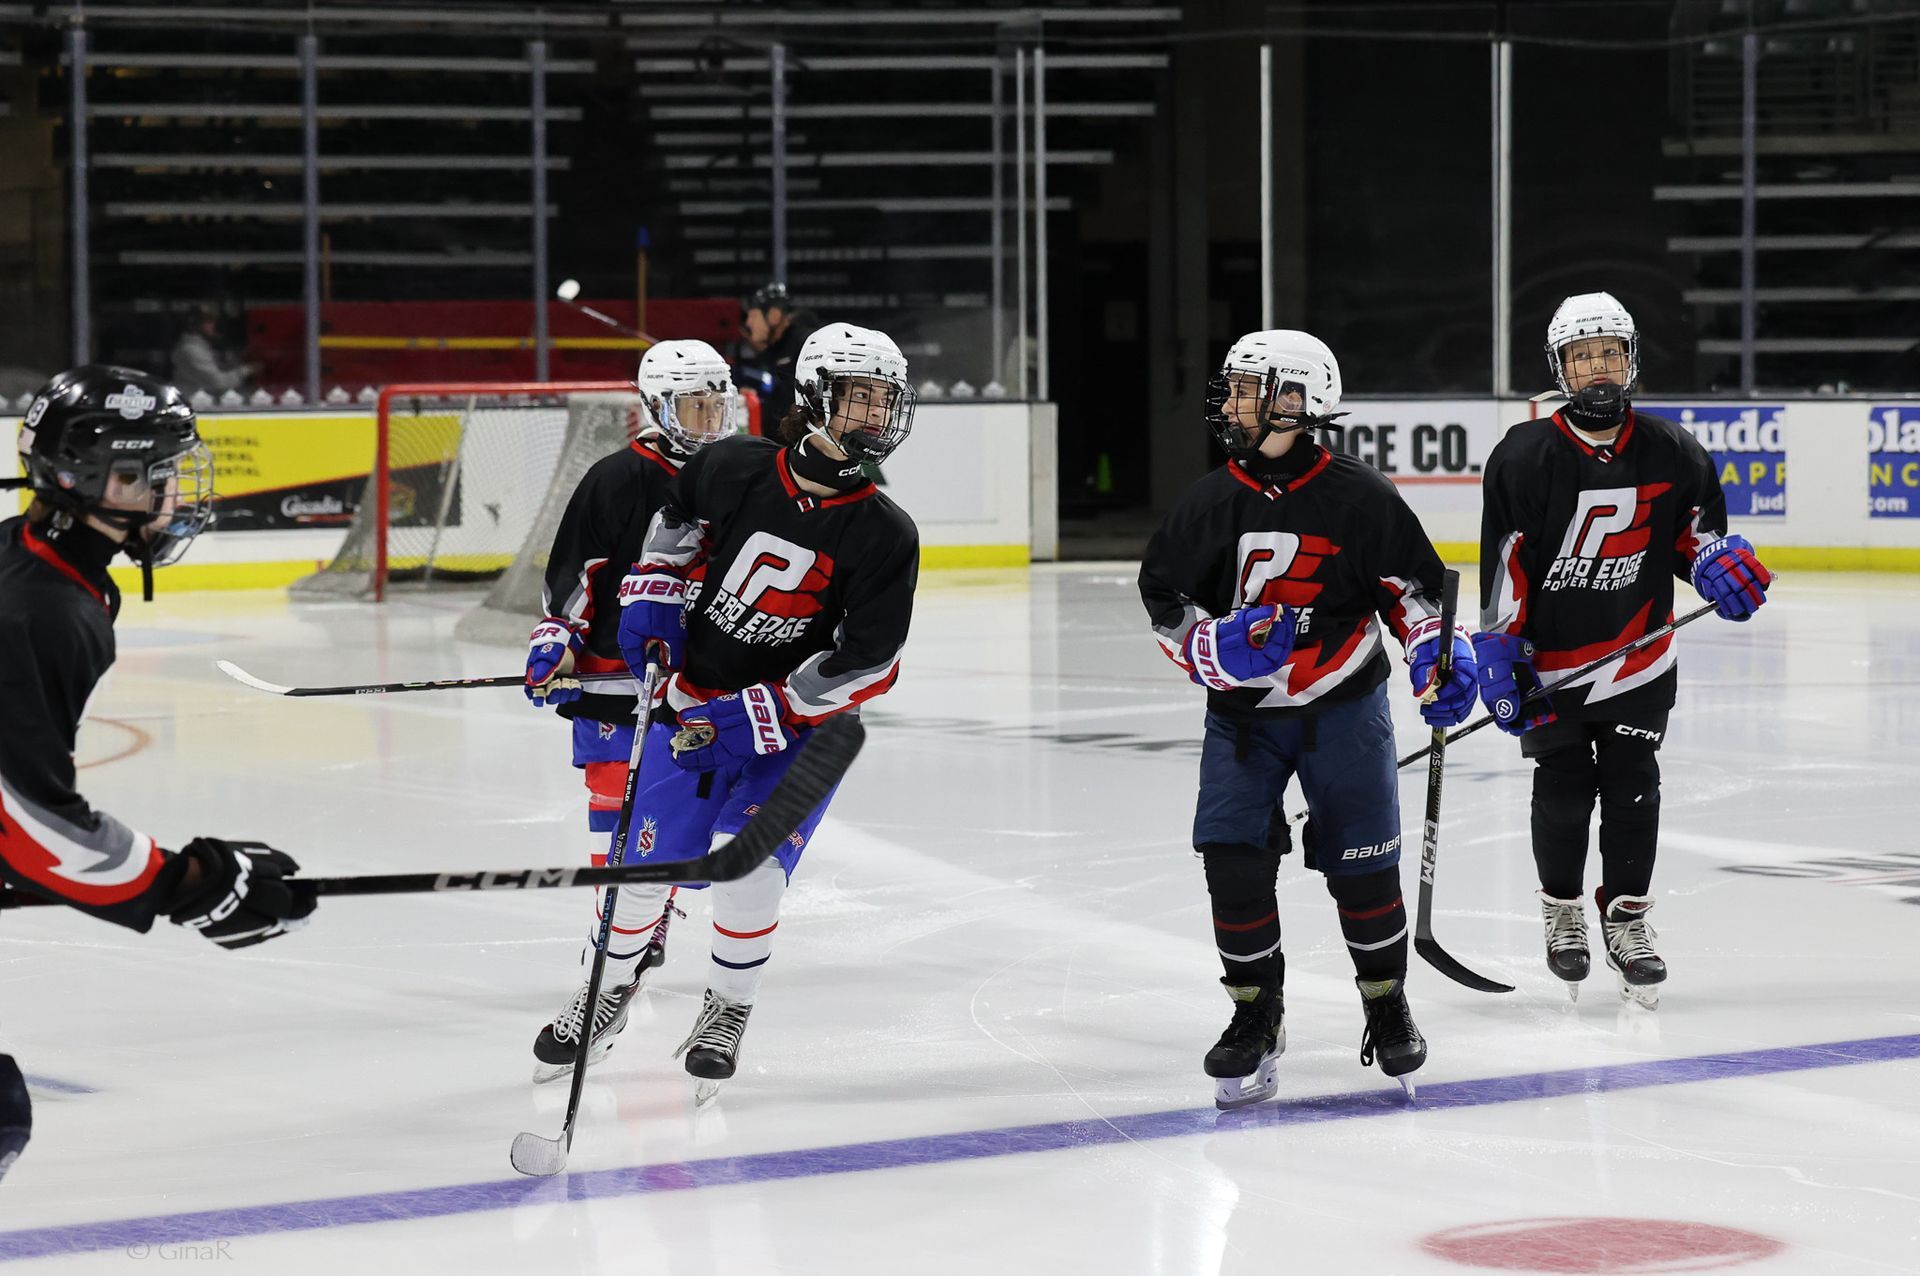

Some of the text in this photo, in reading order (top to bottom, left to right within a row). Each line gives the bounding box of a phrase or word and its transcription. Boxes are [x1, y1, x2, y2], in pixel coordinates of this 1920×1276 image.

[1280, 367, 1310, 377] CCM
[111, 440, 155, 450] CCM
[1412, 424, 1481, 473] CO.
[1546, 549, 1648, 580] PRO EDGE
[1541, 571, 1639, 592] POWER SKATING
[711, 588, 748, 623] PRO
[743, 611, 814, 640] EDGE
[1614, 723, 1662, 743] CCM
[1341, 834, 1401, 861] BAUER
[1419, 818, 1439, 887] CCM
[181, 850, 253, 929] CCM
[433, 867, 580, 893] CCM
